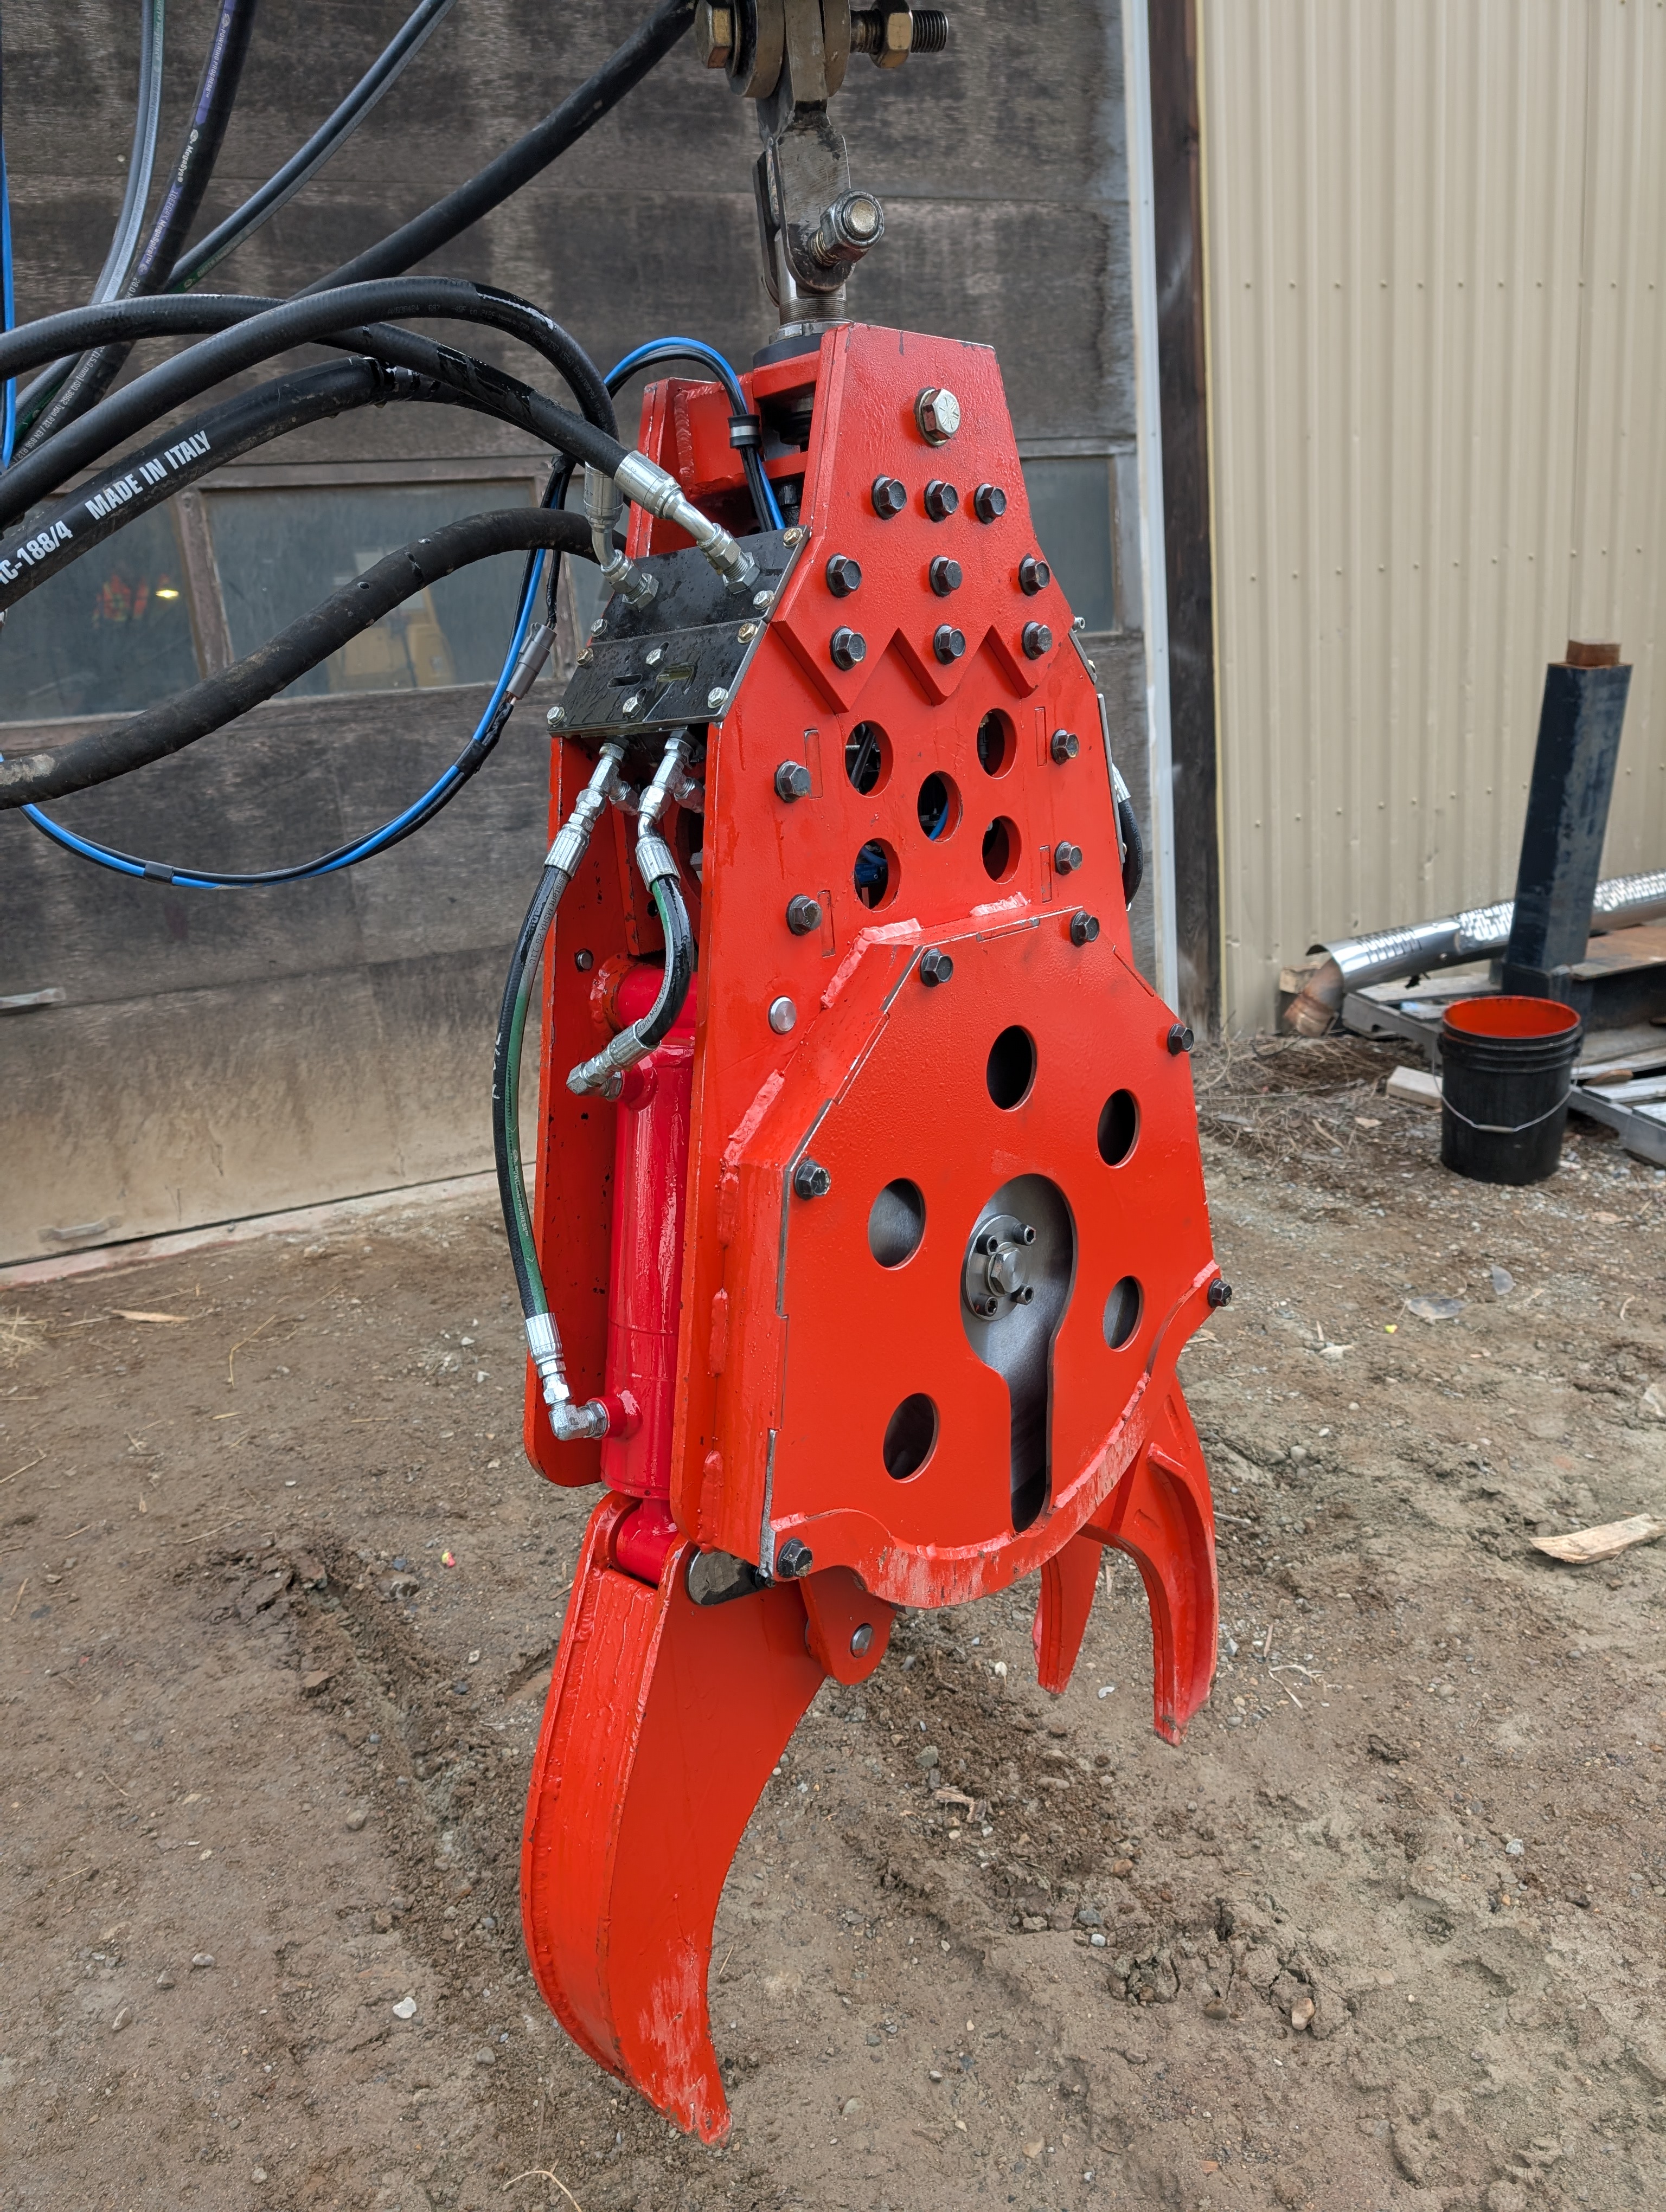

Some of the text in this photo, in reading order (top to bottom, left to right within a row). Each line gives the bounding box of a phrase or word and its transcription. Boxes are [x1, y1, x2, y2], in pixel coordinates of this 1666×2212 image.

[214, 28, 226, 61] POWERING
[71, 380, 82, 391] ISO
[573, 365, 597, 400] Engineered
[60, 390, 75, 406] 3862
[51, 404, 65, 416] Type
[42, 416, 55, 428] R12
[34, 430, 44, 439] EN
[25, 438, 37, 449] 856
[16, 447, 29, 459] R12
[85, 473, 143, 520] MADE
[139, 458, 168, 485] IN
[164, 430, 211, 470] ITALY
[539, 908, 554, 931] MSHA
[529, 933, 544, 966] 2G-11C
[649, 996, 663, 1019] MSHA
